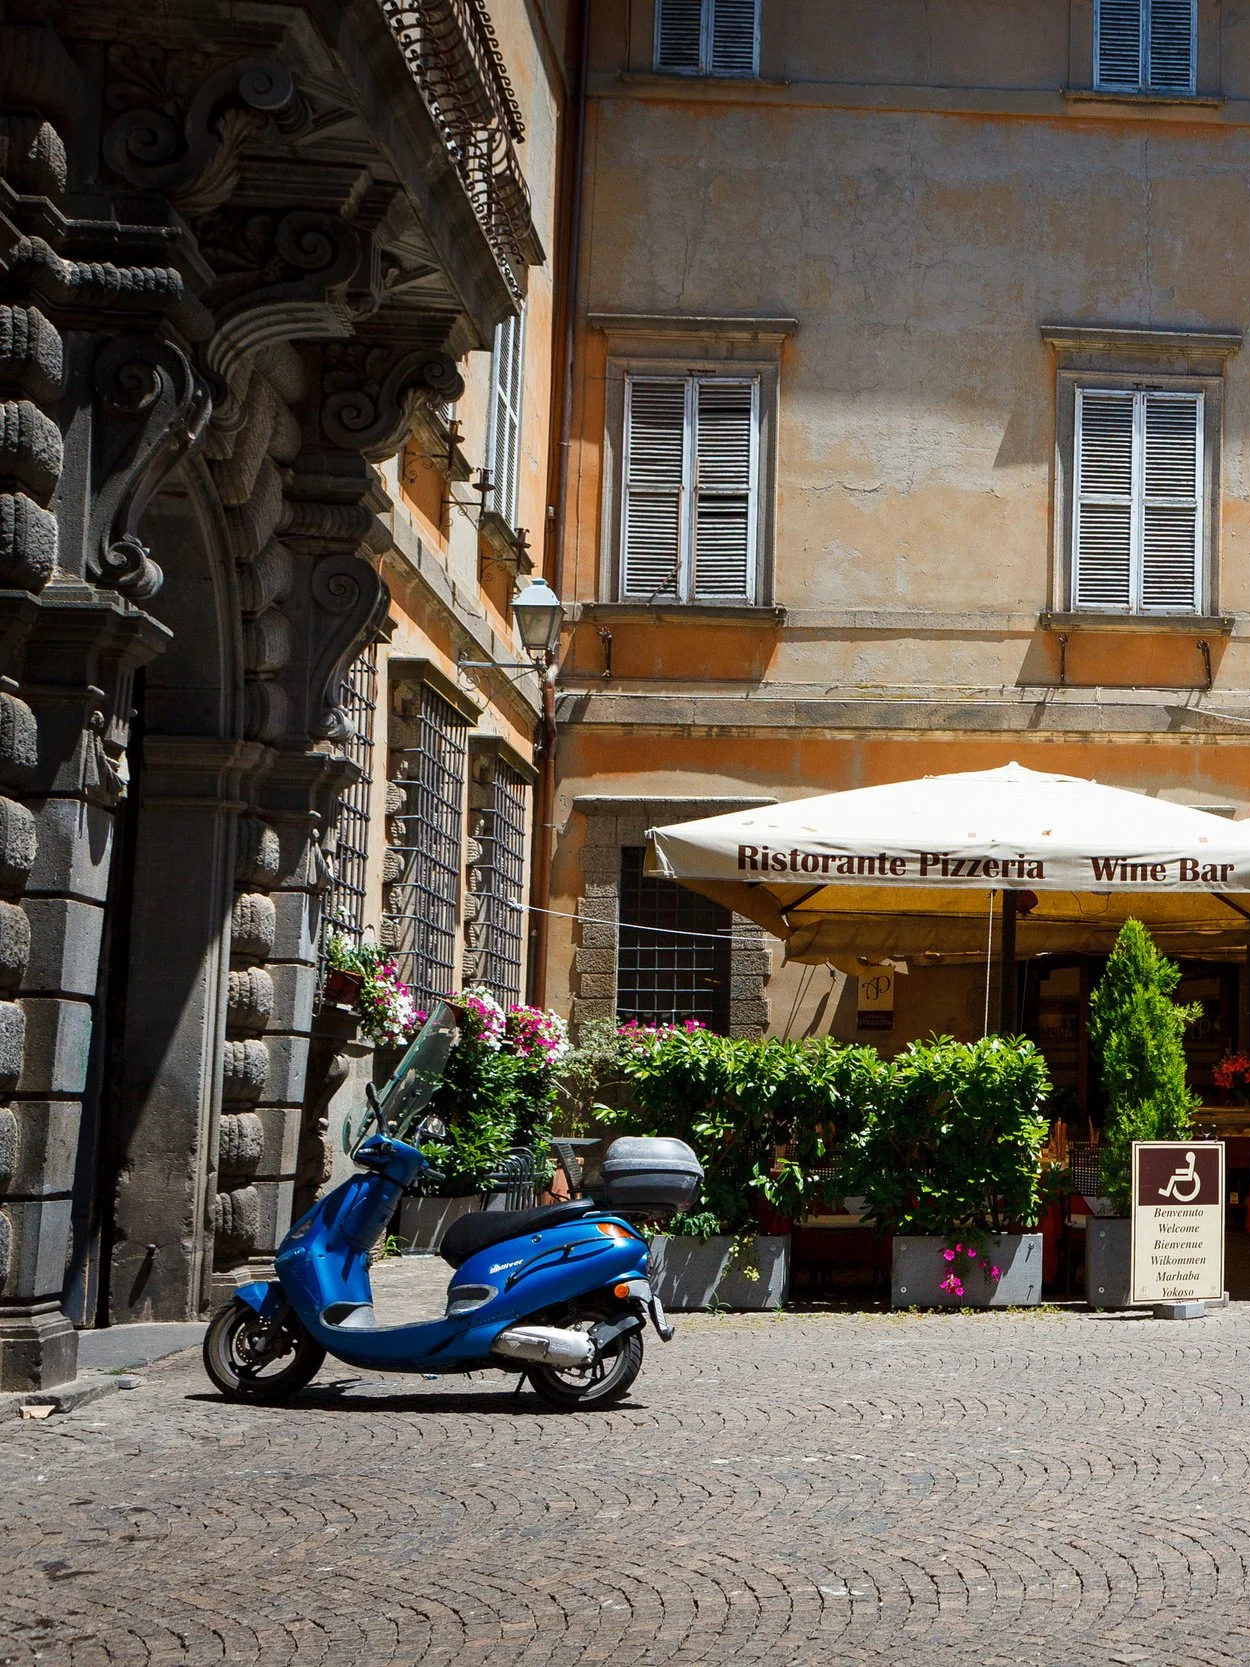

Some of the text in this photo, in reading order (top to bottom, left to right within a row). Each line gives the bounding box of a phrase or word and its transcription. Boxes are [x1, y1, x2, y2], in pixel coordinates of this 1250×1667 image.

[737, 844, 1046, 880] Ristorante Pizzeria
[1090, 857, 1235, 883] Wine Bar
[1154, 1207, 1204, 1218] Benvenuto
[1159, 1223, 1200, 1233] Welcome
[1154, 1239, 1203, 1249] Bienvenue
[1151, 1255, 1206, 1266] Wilkommen
[1156, 1270, 1200, 1282] Marhaba
[1162, 1286, 1195, 1297] Yokoso
